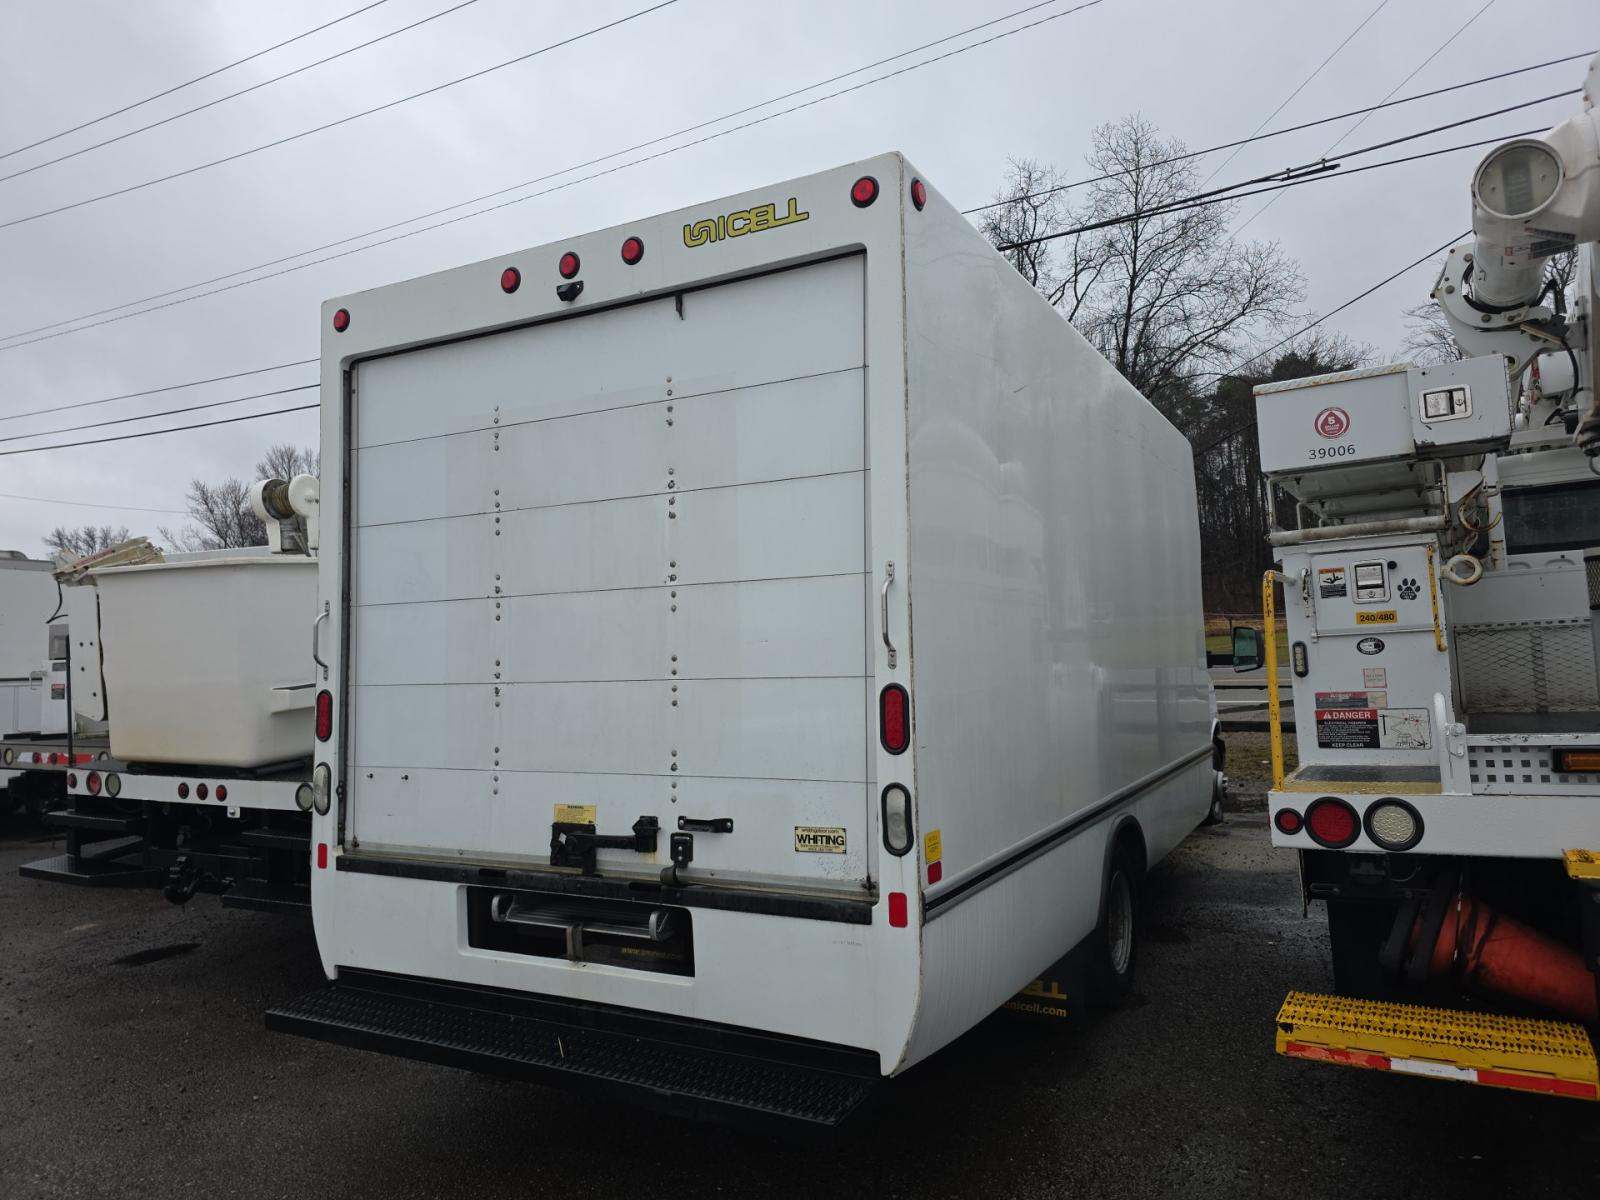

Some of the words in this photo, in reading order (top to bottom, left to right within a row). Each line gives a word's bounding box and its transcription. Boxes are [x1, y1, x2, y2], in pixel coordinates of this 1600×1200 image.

[683, 197, 809, 248] UNICELL
[1308, 444, 1356, 460] 39006
[1360, 613, 1395, 622] 240/480
[1333, 711, 1371, 720] DANGER
[796, 833, 845, 846] WHITING
